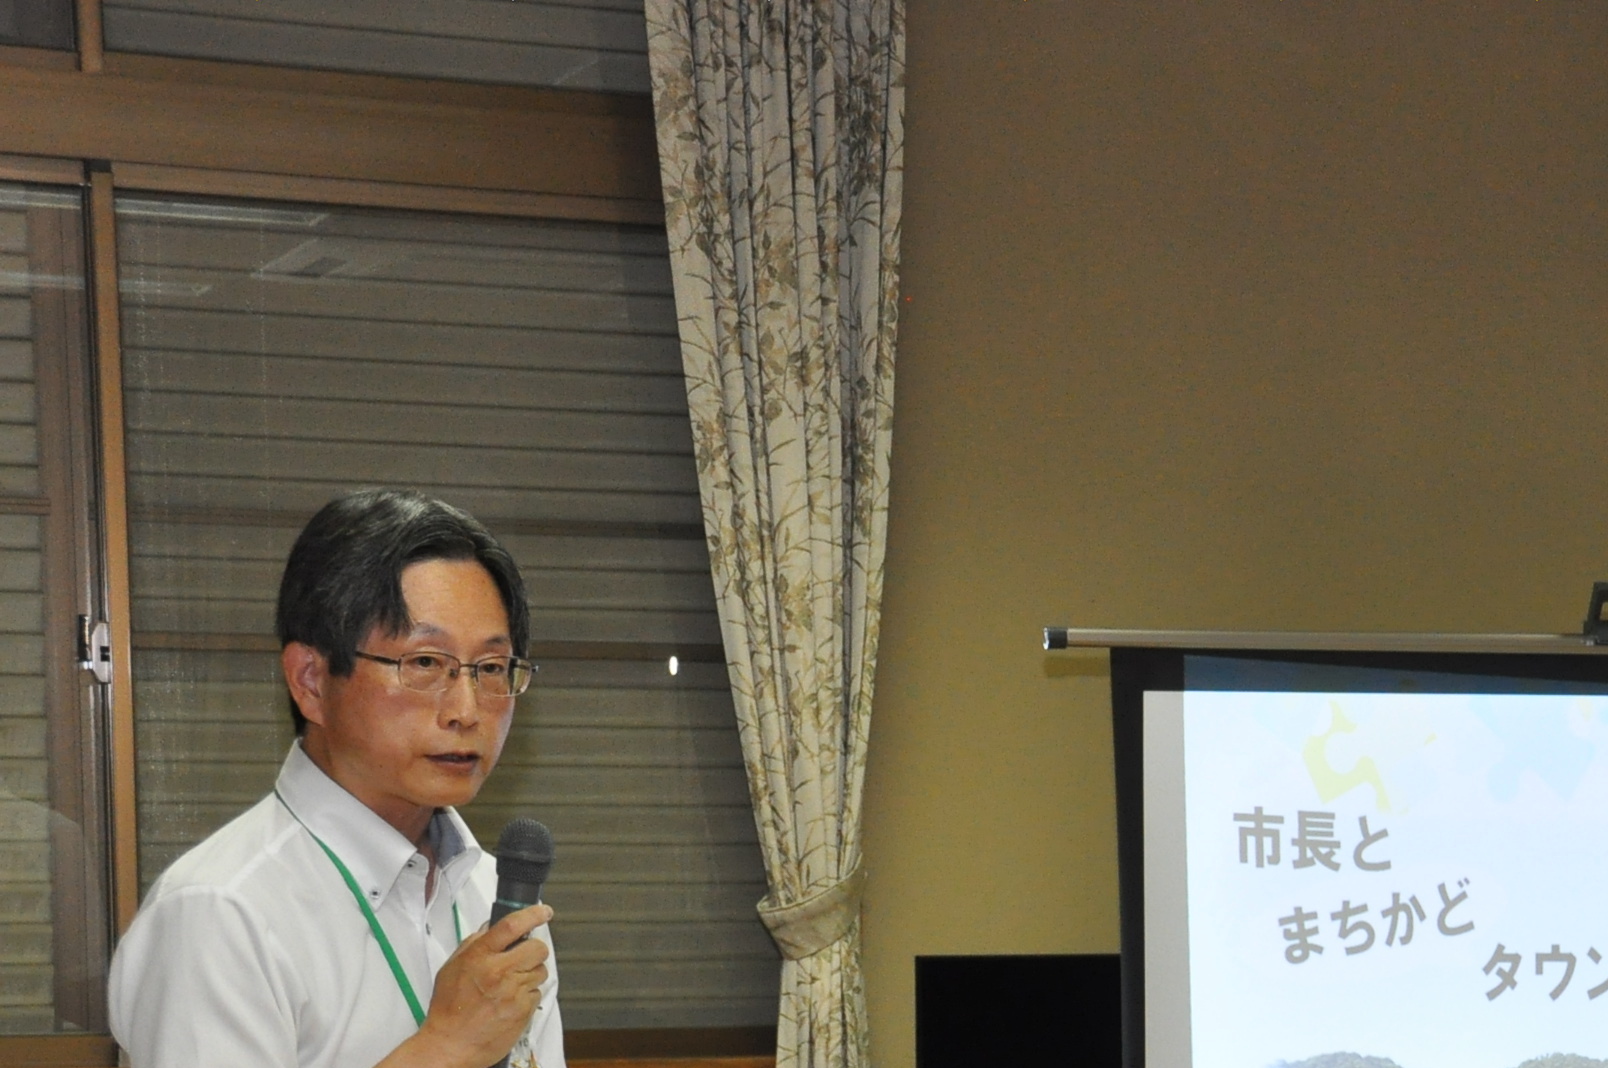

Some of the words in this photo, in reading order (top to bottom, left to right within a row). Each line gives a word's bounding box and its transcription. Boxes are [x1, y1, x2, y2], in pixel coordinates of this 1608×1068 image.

[1233, 806, 1391, 872] 市長と
[1278, 877, 1475, 964] まちかど
